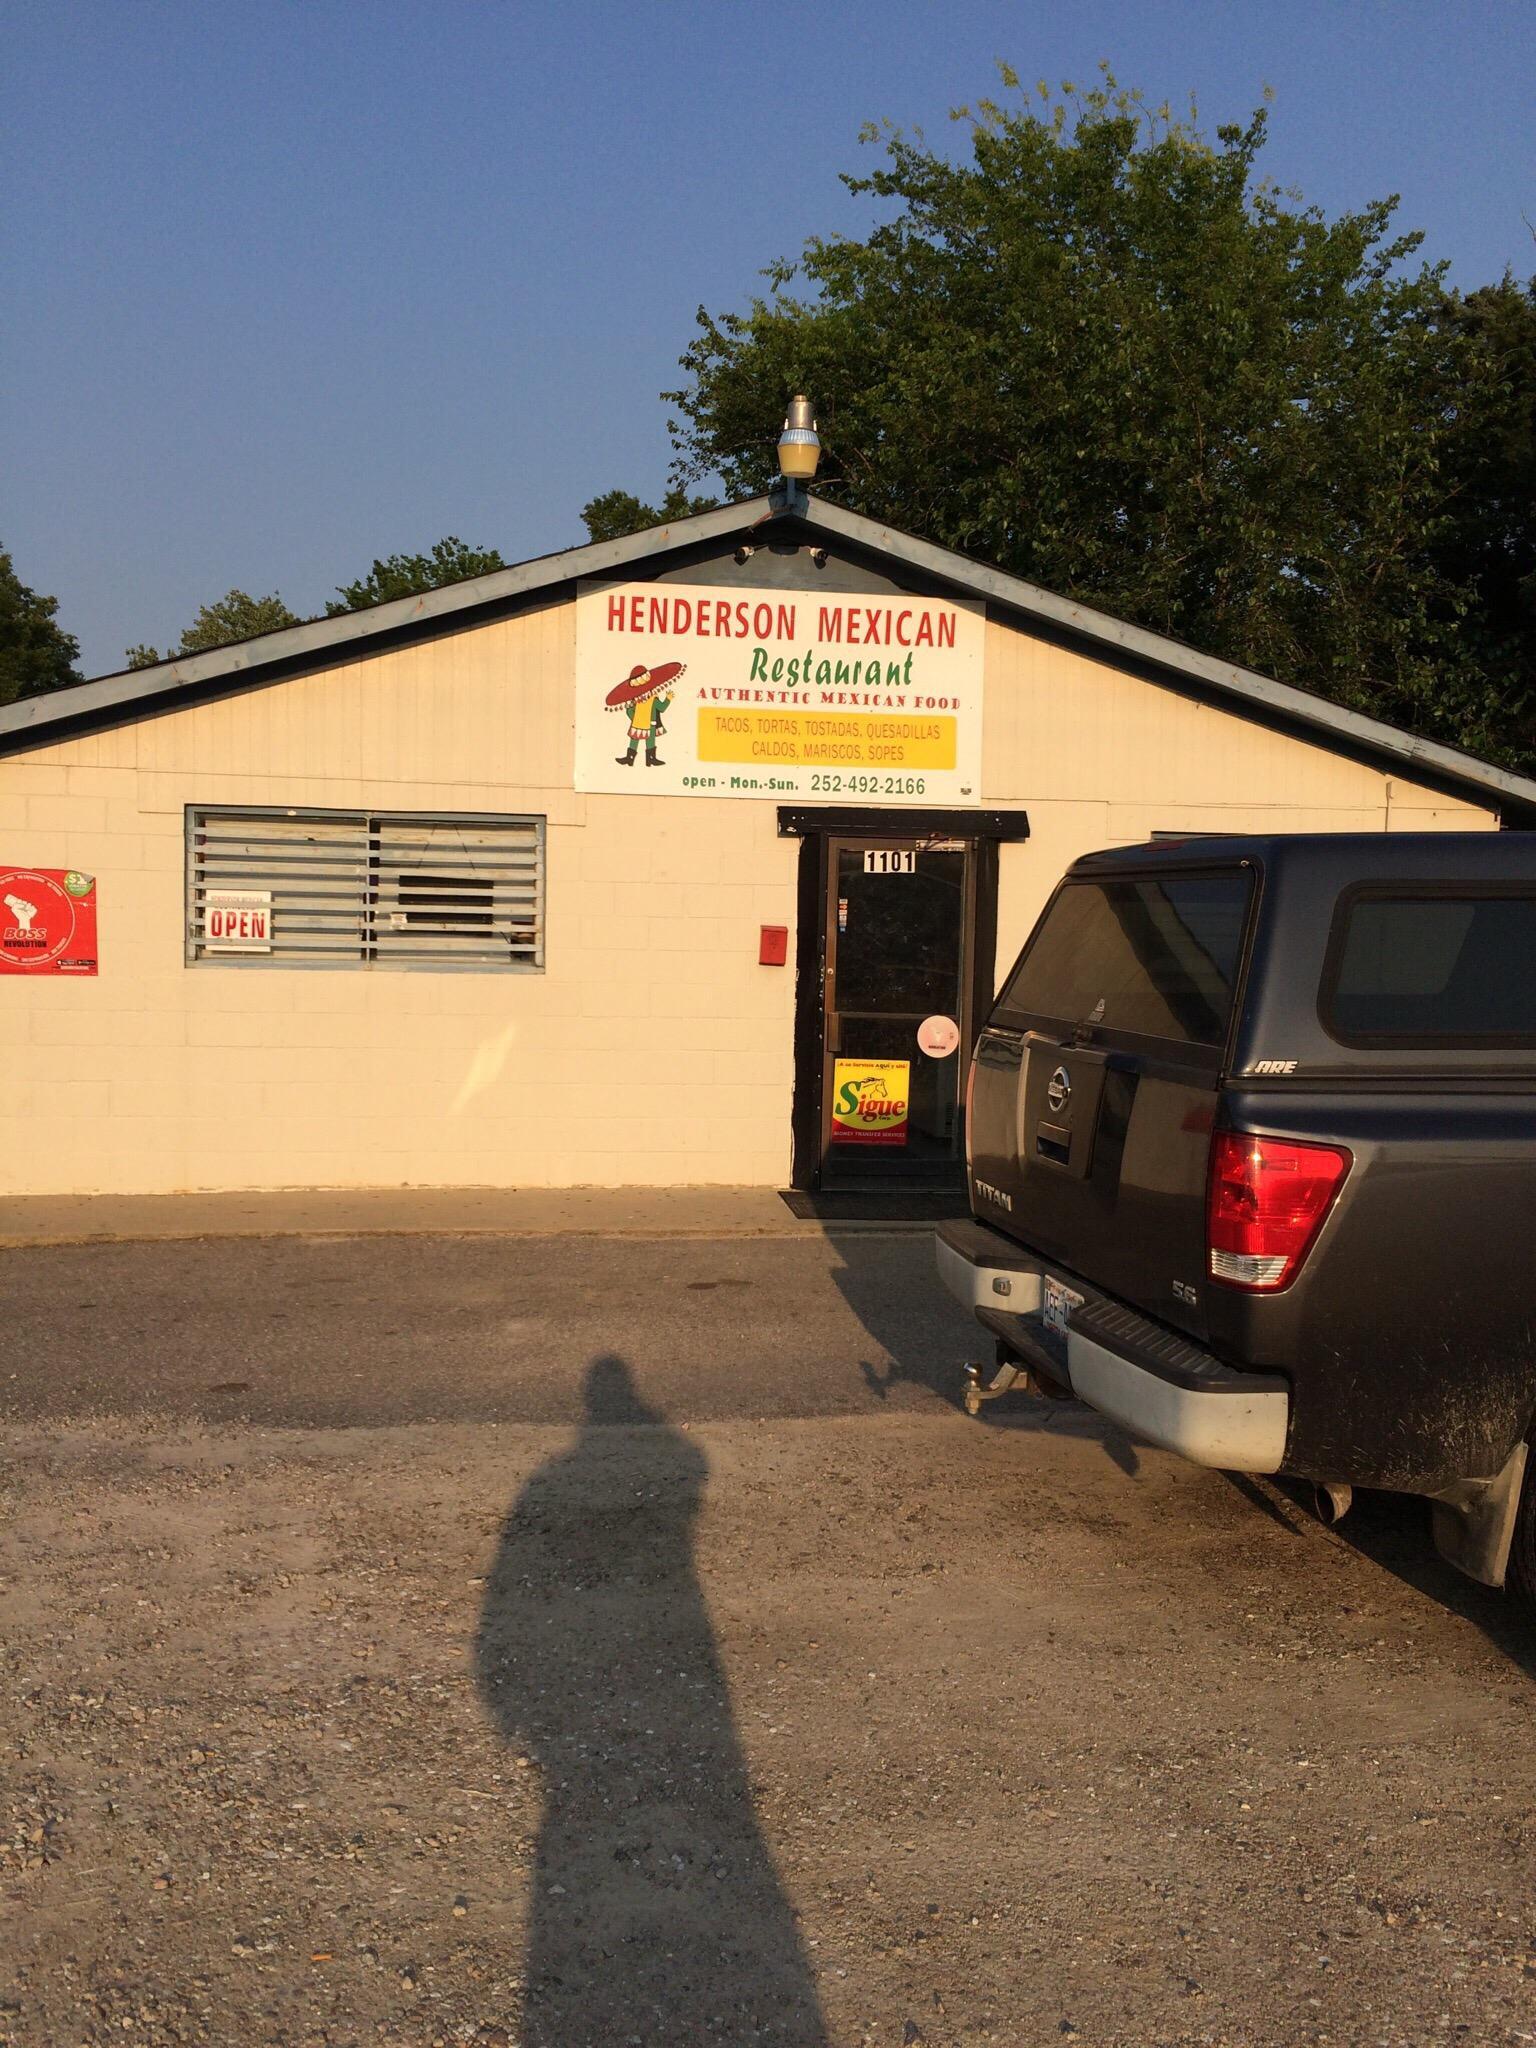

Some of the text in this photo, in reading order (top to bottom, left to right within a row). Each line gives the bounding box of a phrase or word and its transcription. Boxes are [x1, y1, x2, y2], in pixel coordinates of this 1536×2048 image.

[607, 595, 956, 648] HENDERSON MEXICAN
[750, 647, 913, 688] Restaurant
[696, 687, 961, 710] AUTHENTIC MEXICAN FOOD
[716, 717, 753, 735] TACOS,
[757, 718, 801, 736] TORTAS,
[866, 723, 941, 740] QUESADILLAS
[752, 740, 905, 761] CALDOS, MARISCOS, SOPES
[682, 776, 716, 789] open
[730, 776, 799, 791] Mon.-Sun.
[811, 774, 926, 795] 252-492-2166
[867, 851, 914, 872] 1101
[3, 927, 47, 940] BOSS
[211, 910, 265, 938] OPEN
[4, 940, 47, 948] REVOLUTION
[1254, 1060, 1298, 1074] ARE
[835, 1080, 906, 1123] Sigue
[975, 1179, 1012, 1212] TITAN
